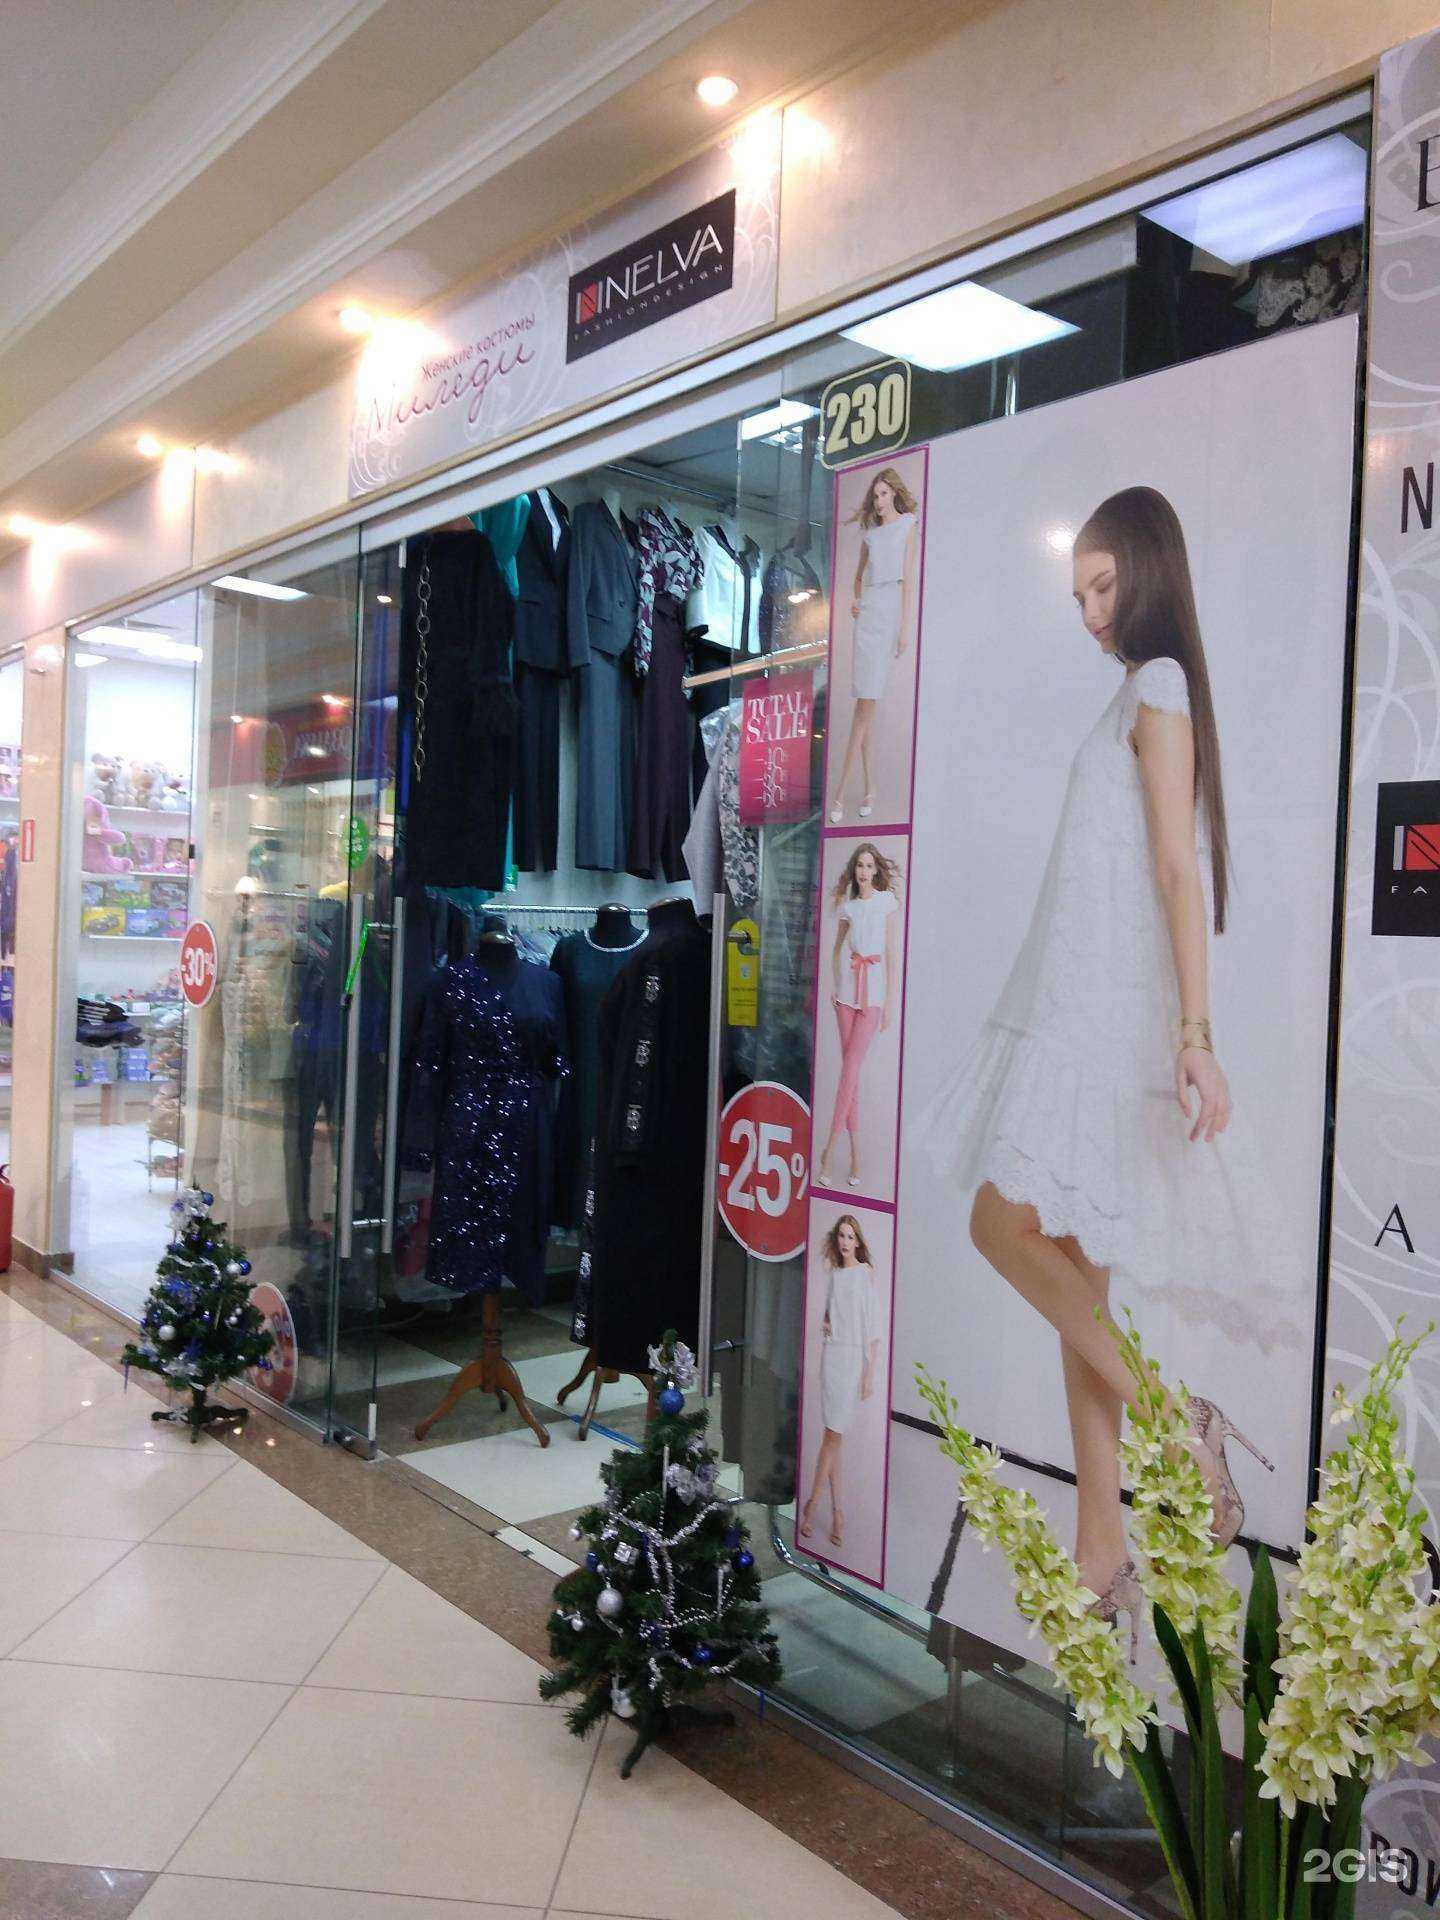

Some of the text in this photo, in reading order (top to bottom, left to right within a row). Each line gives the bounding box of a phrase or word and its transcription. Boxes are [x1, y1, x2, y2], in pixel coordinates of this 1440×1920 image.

[605, 224, 724, 310] NELVA
[826, 373, 905, 454] 230
[746, 712, 807, 743] SALE
